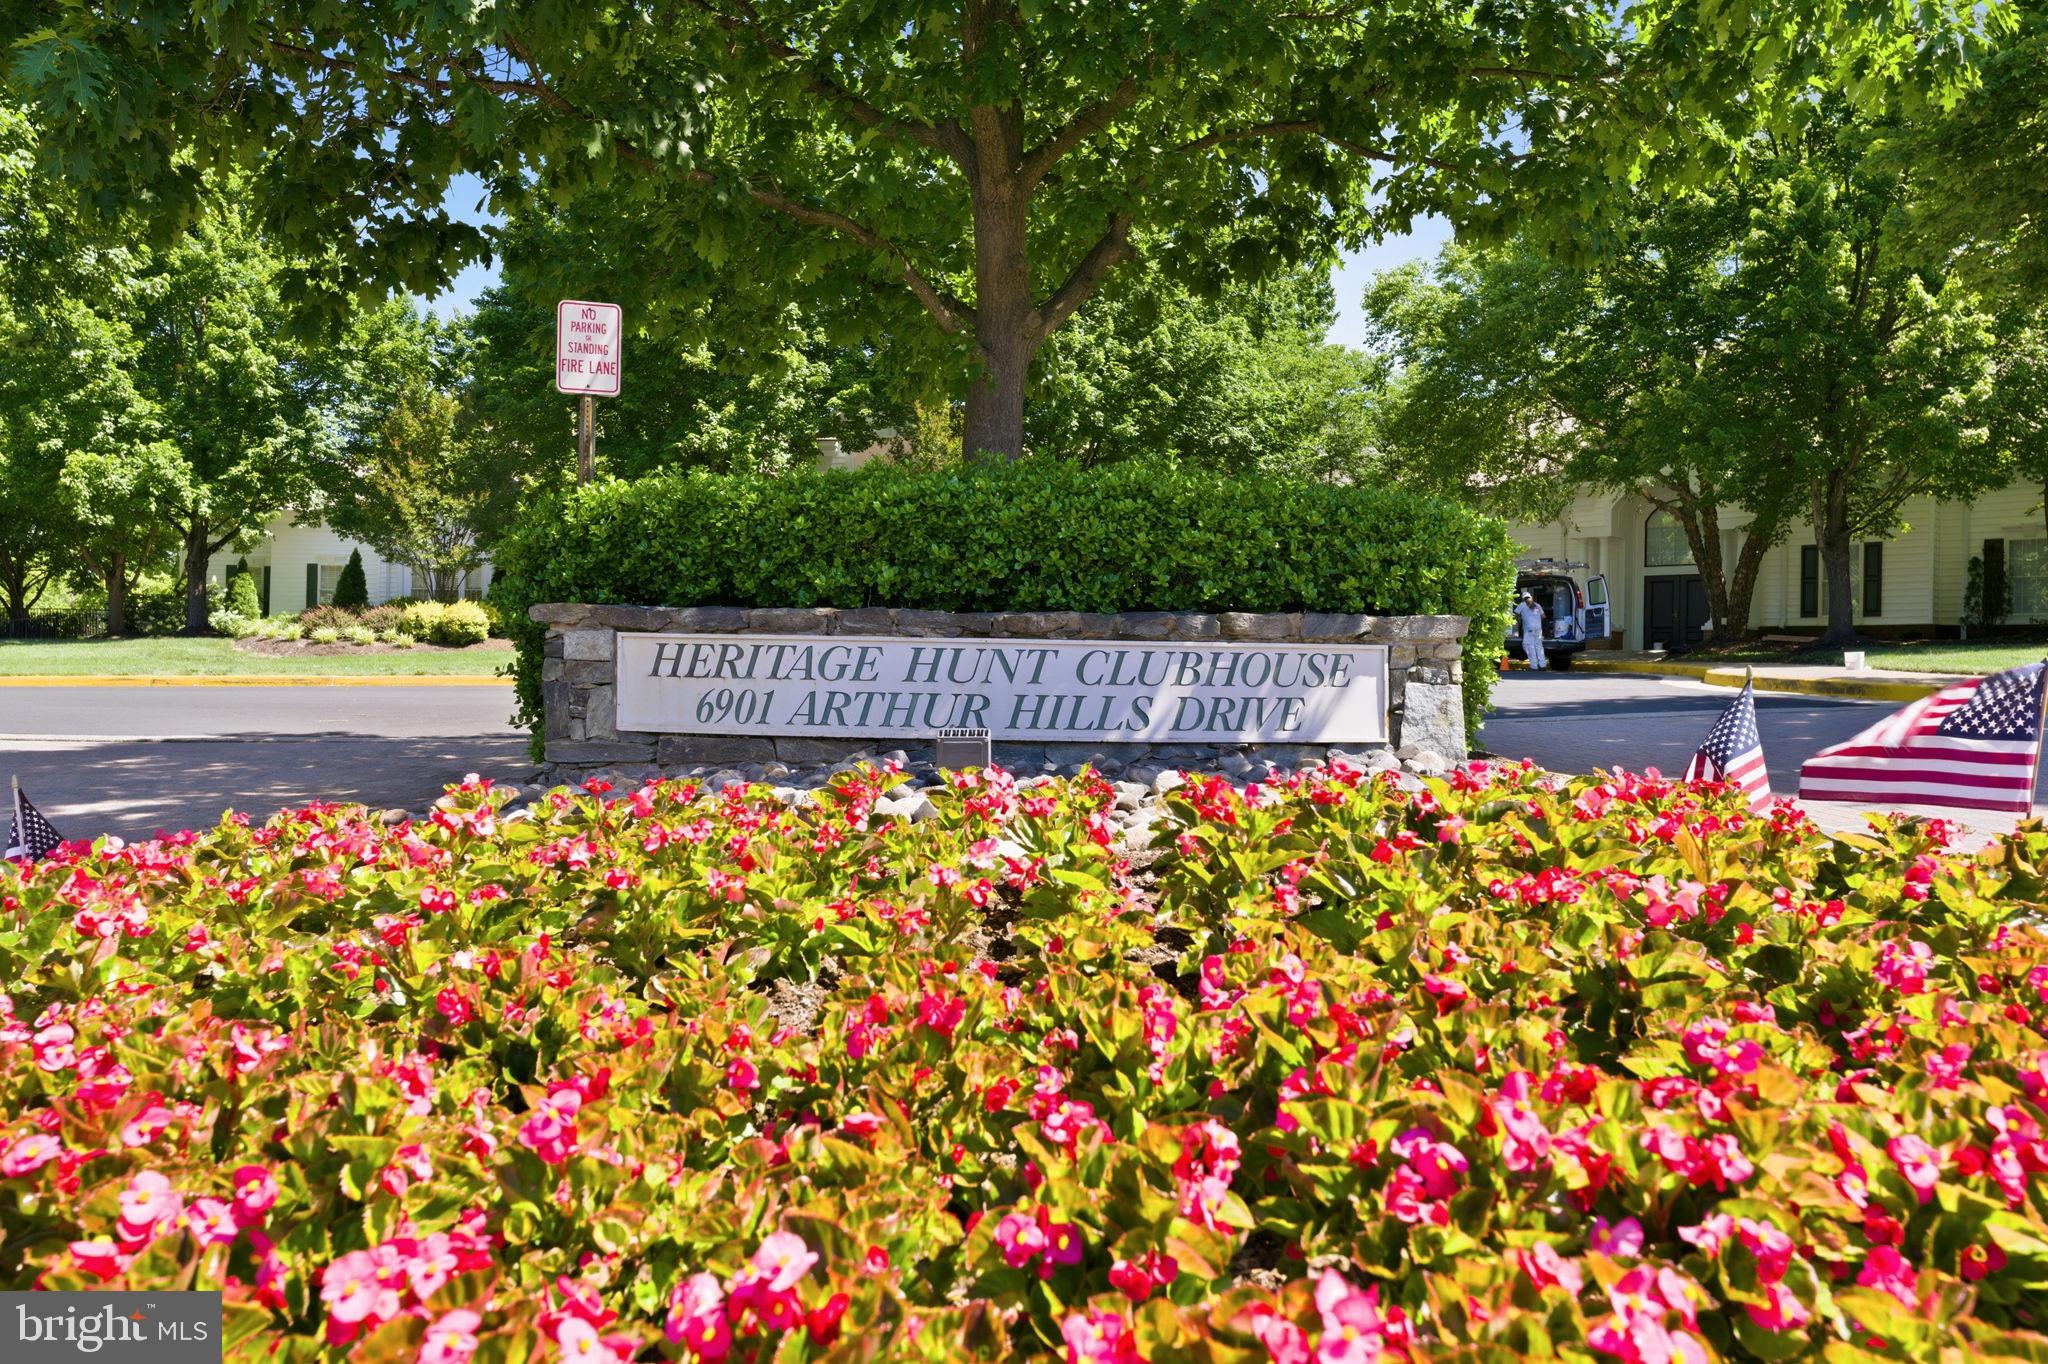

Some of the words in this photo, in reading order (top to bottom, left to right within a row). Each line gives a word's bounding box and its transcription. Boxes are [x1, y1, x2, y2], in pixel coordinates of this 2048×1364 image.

[581, 309, 596, 320] NO
[570, 321, 606, 334] PARKING
[568, 342, 608, 355] STANDING
[561, 358, 584, 373] FIRE
[589, 361, 616, 375] LANE
[648, 642, 884, 682] HERITAGE
[901, 647, 1059, 685] HUNT
[1075, 649, 1355, 688] CLUBHOUSE
[696, 687, 775, 725] 6901
[786, 690, 991, 729] ARTHUR
[1005, 694, 1154, 731] HILLS
[1168, 696, 1306, 732] DRIVE
